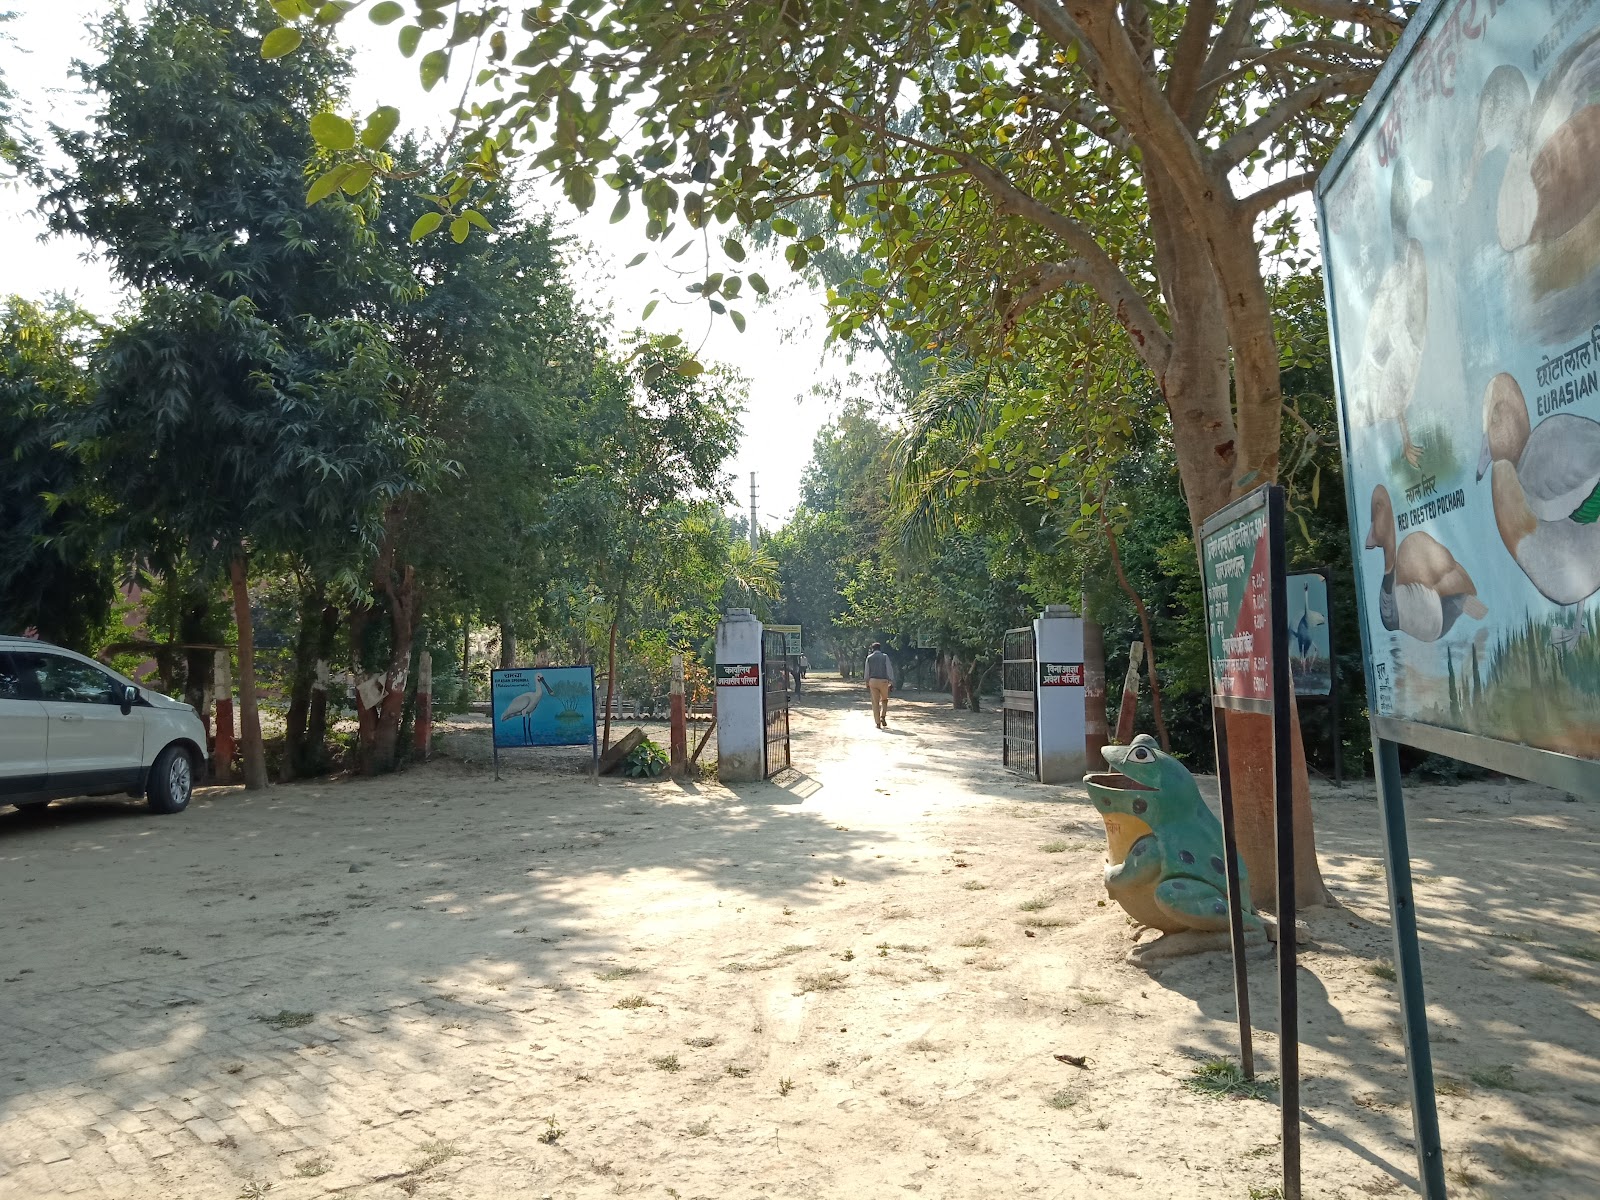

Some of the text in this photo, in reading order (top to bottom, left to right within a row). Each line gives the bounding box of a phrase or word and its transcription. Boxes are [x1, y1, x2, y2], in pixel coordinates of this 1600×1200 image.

[1536, 355, 1564, 388] छोटा
[1564, 341, 1591, 377] लाल
[1537, 371, 1599, 417] EURASIAN
[1398, 489, 1465, 531] RED CRESTED POCHARD
[1405, 474, 1437, 507] लाल सिर
[1043, 673, 1080, 685] प्रवेश वर्जित
